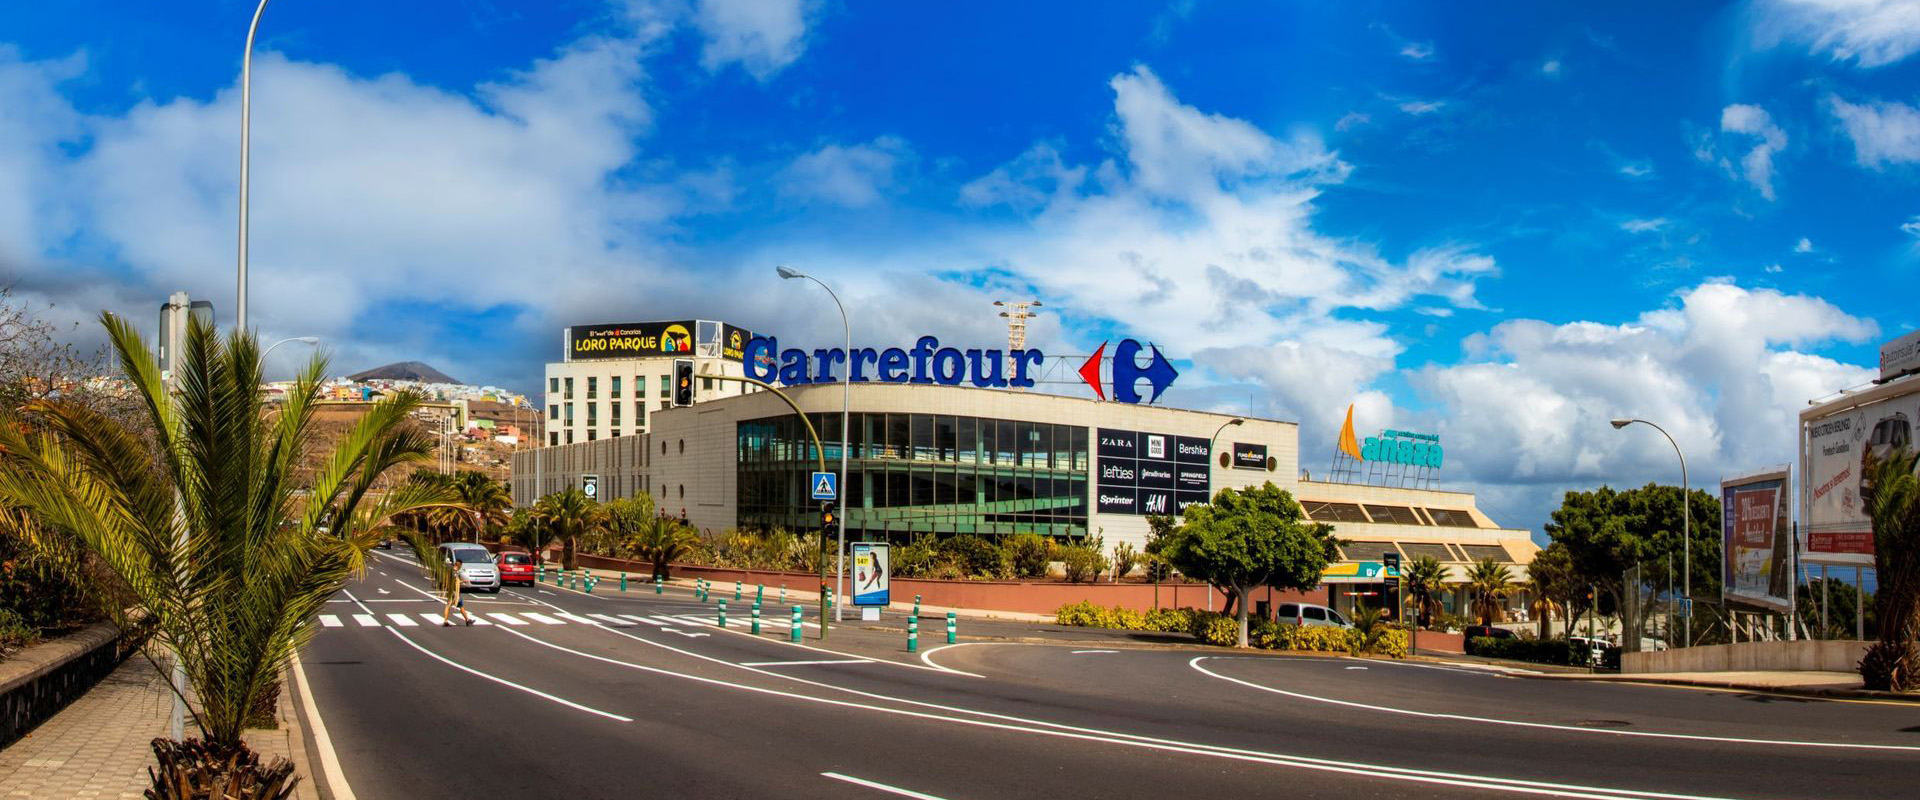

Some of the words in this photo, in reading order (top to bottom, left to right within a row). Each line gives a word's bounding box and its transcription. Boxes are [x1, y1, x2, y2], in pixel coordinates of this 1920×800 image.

[576, 338, 607, 352] LORO
[609, 336, 657, 352] PARQUE
[743, 334, 1044, 388] Carrefour
[1101, 437, 1133, 448] ZARA
[1150, 438, 1162, 446] MINI
[1150, 446, 1162, 454] GOOD
[1178, 443, 1208, 456] Bershka
[1103, 464, 1134, 479] lefties
[1180, 471, 1207, 479] SPRINGFIELD
[1099, 494, 1134, 505] Sprinter
[1145, 493, 1167, 513] H&M
